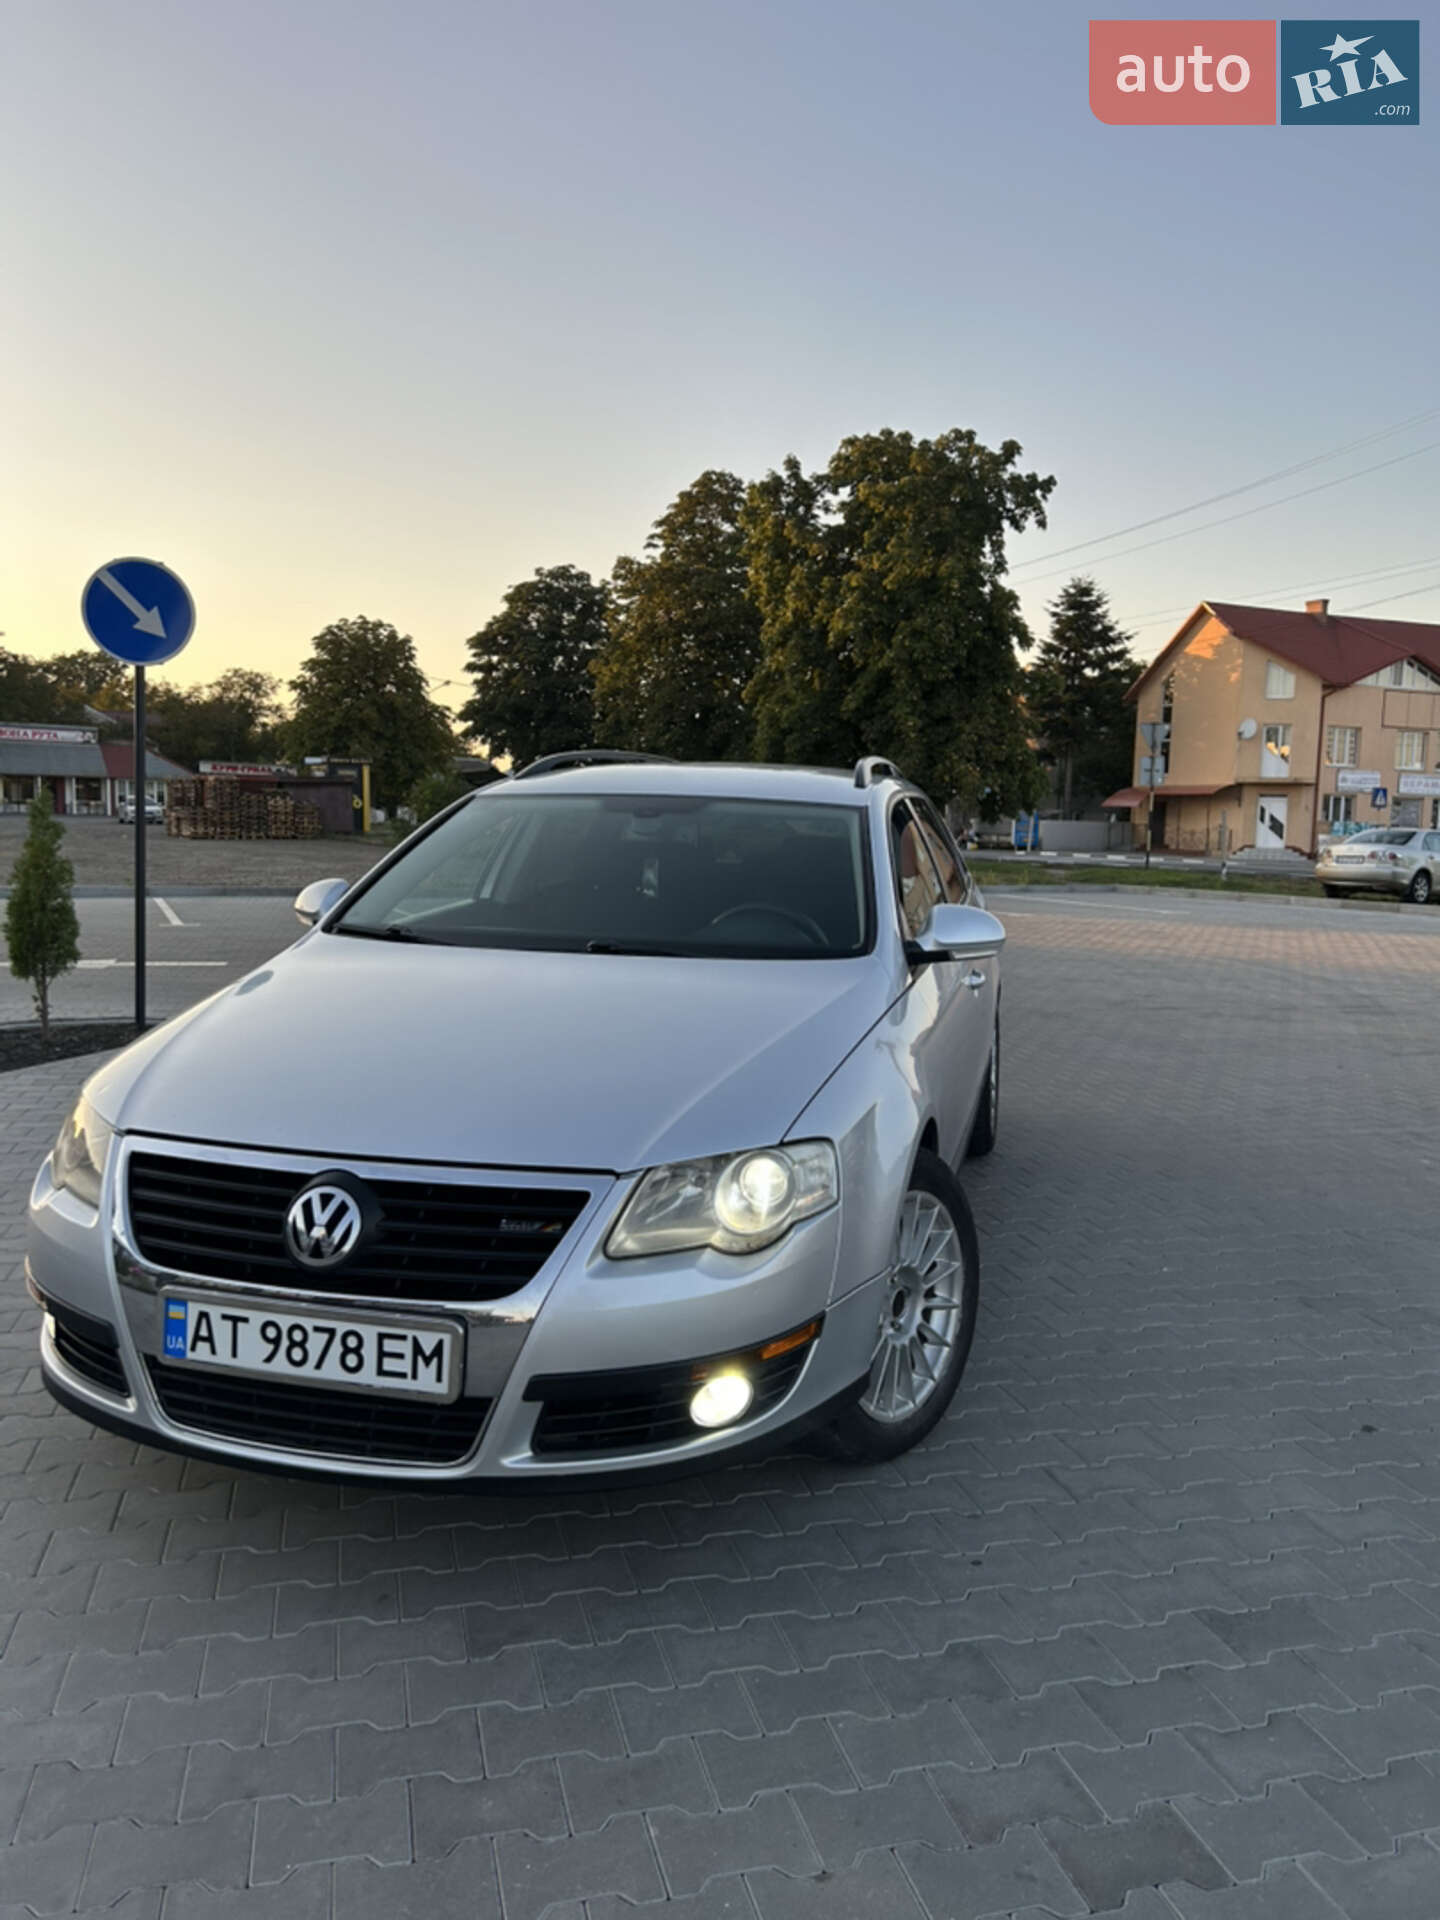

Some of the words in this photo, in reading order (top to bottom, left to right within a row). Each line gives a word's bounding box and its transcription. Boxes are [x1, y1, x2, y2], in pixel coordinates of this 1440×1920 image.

[166, 1334, 185, 1350] UA
[190, 1311, 249, 1359] AT
[260, 1319, 365, 1375] 9878
[376, 1332, 445, 1383] EM
